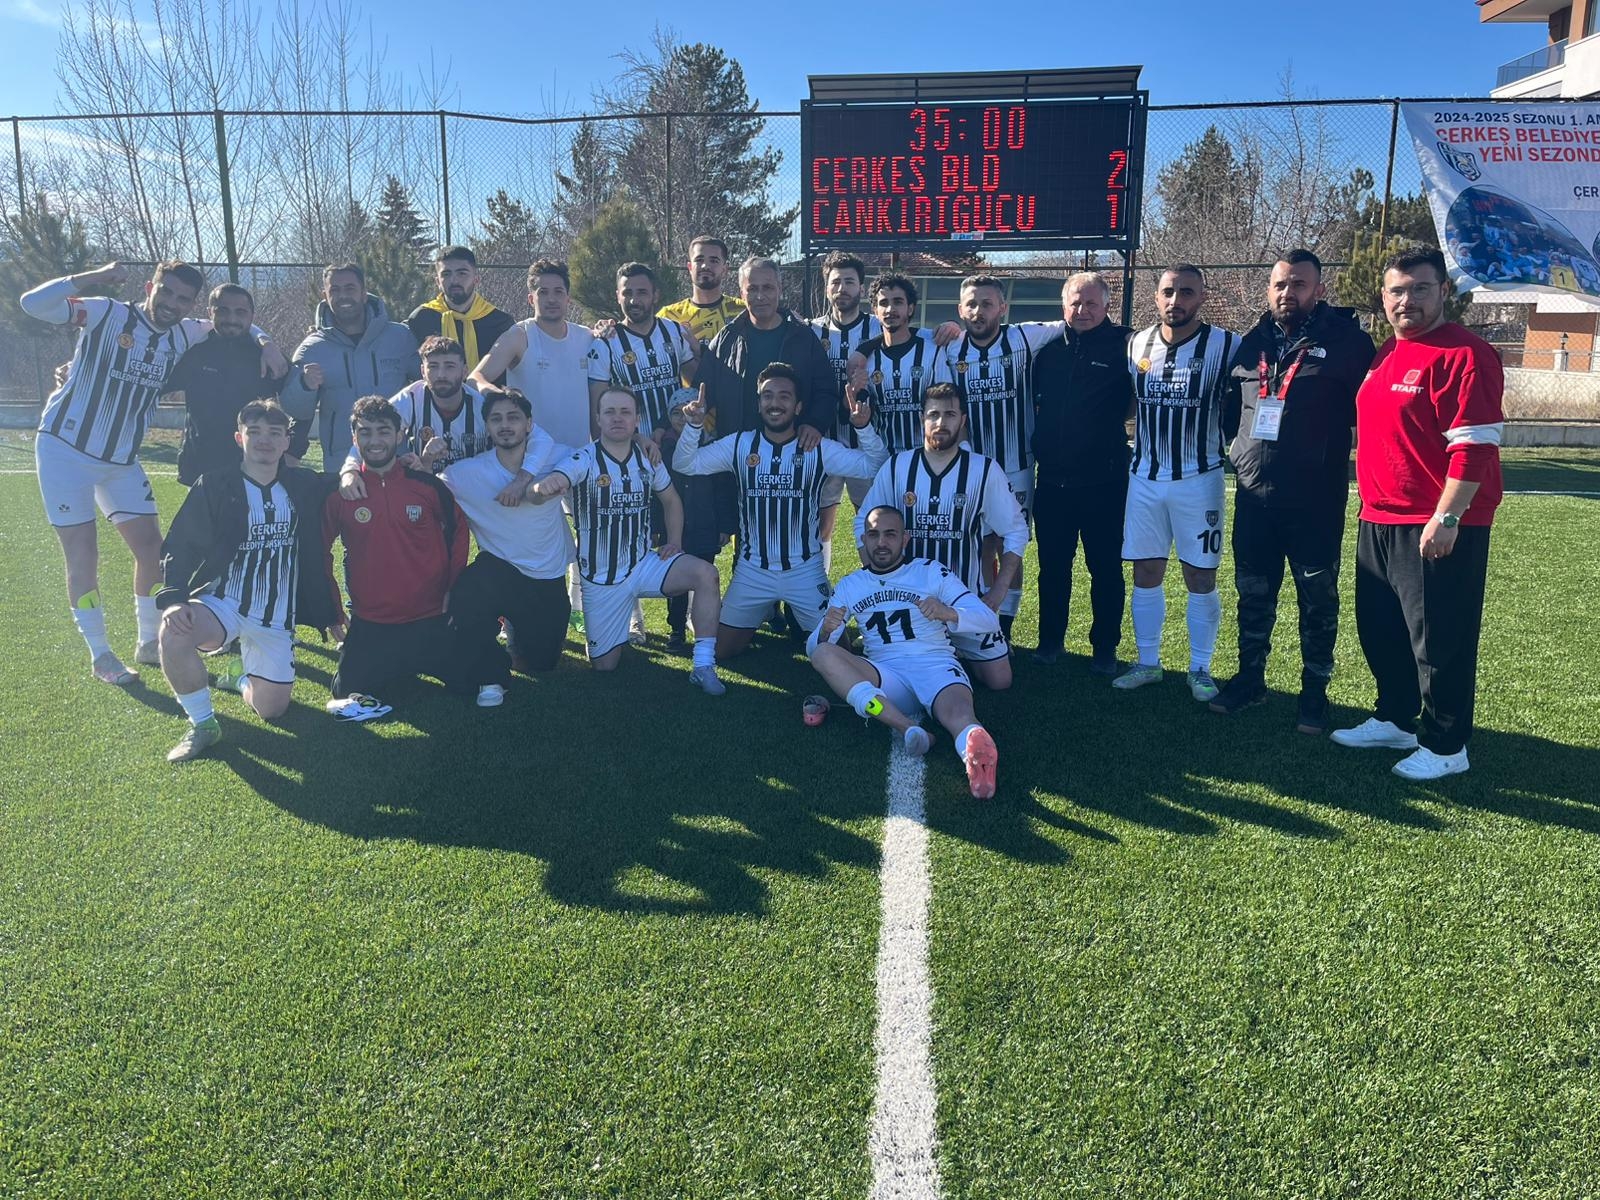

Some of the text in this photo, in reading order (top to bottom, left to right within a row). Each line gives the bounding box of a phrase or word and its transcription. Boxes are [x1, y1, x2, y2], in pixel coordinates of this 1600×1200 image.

[1434, 112, 1510, 124] 2024-2025
[1513, 113, 1566, 126] SEZONU
[1570, 114, 1582, 126] 1.
[1479, 144, 1523, 162] YENİ
[813, 154, 1000, 194] CERKES BLD
[1107, 150, 1126, 189] 2
[1573, 185, 1600, 200] ÇER
[1106, 194, 1118, 230] 1
[1391, 384, 1424, 394] START
[1197, 530, 1221, 554] 10
[865, 609, 916, 644] 11
